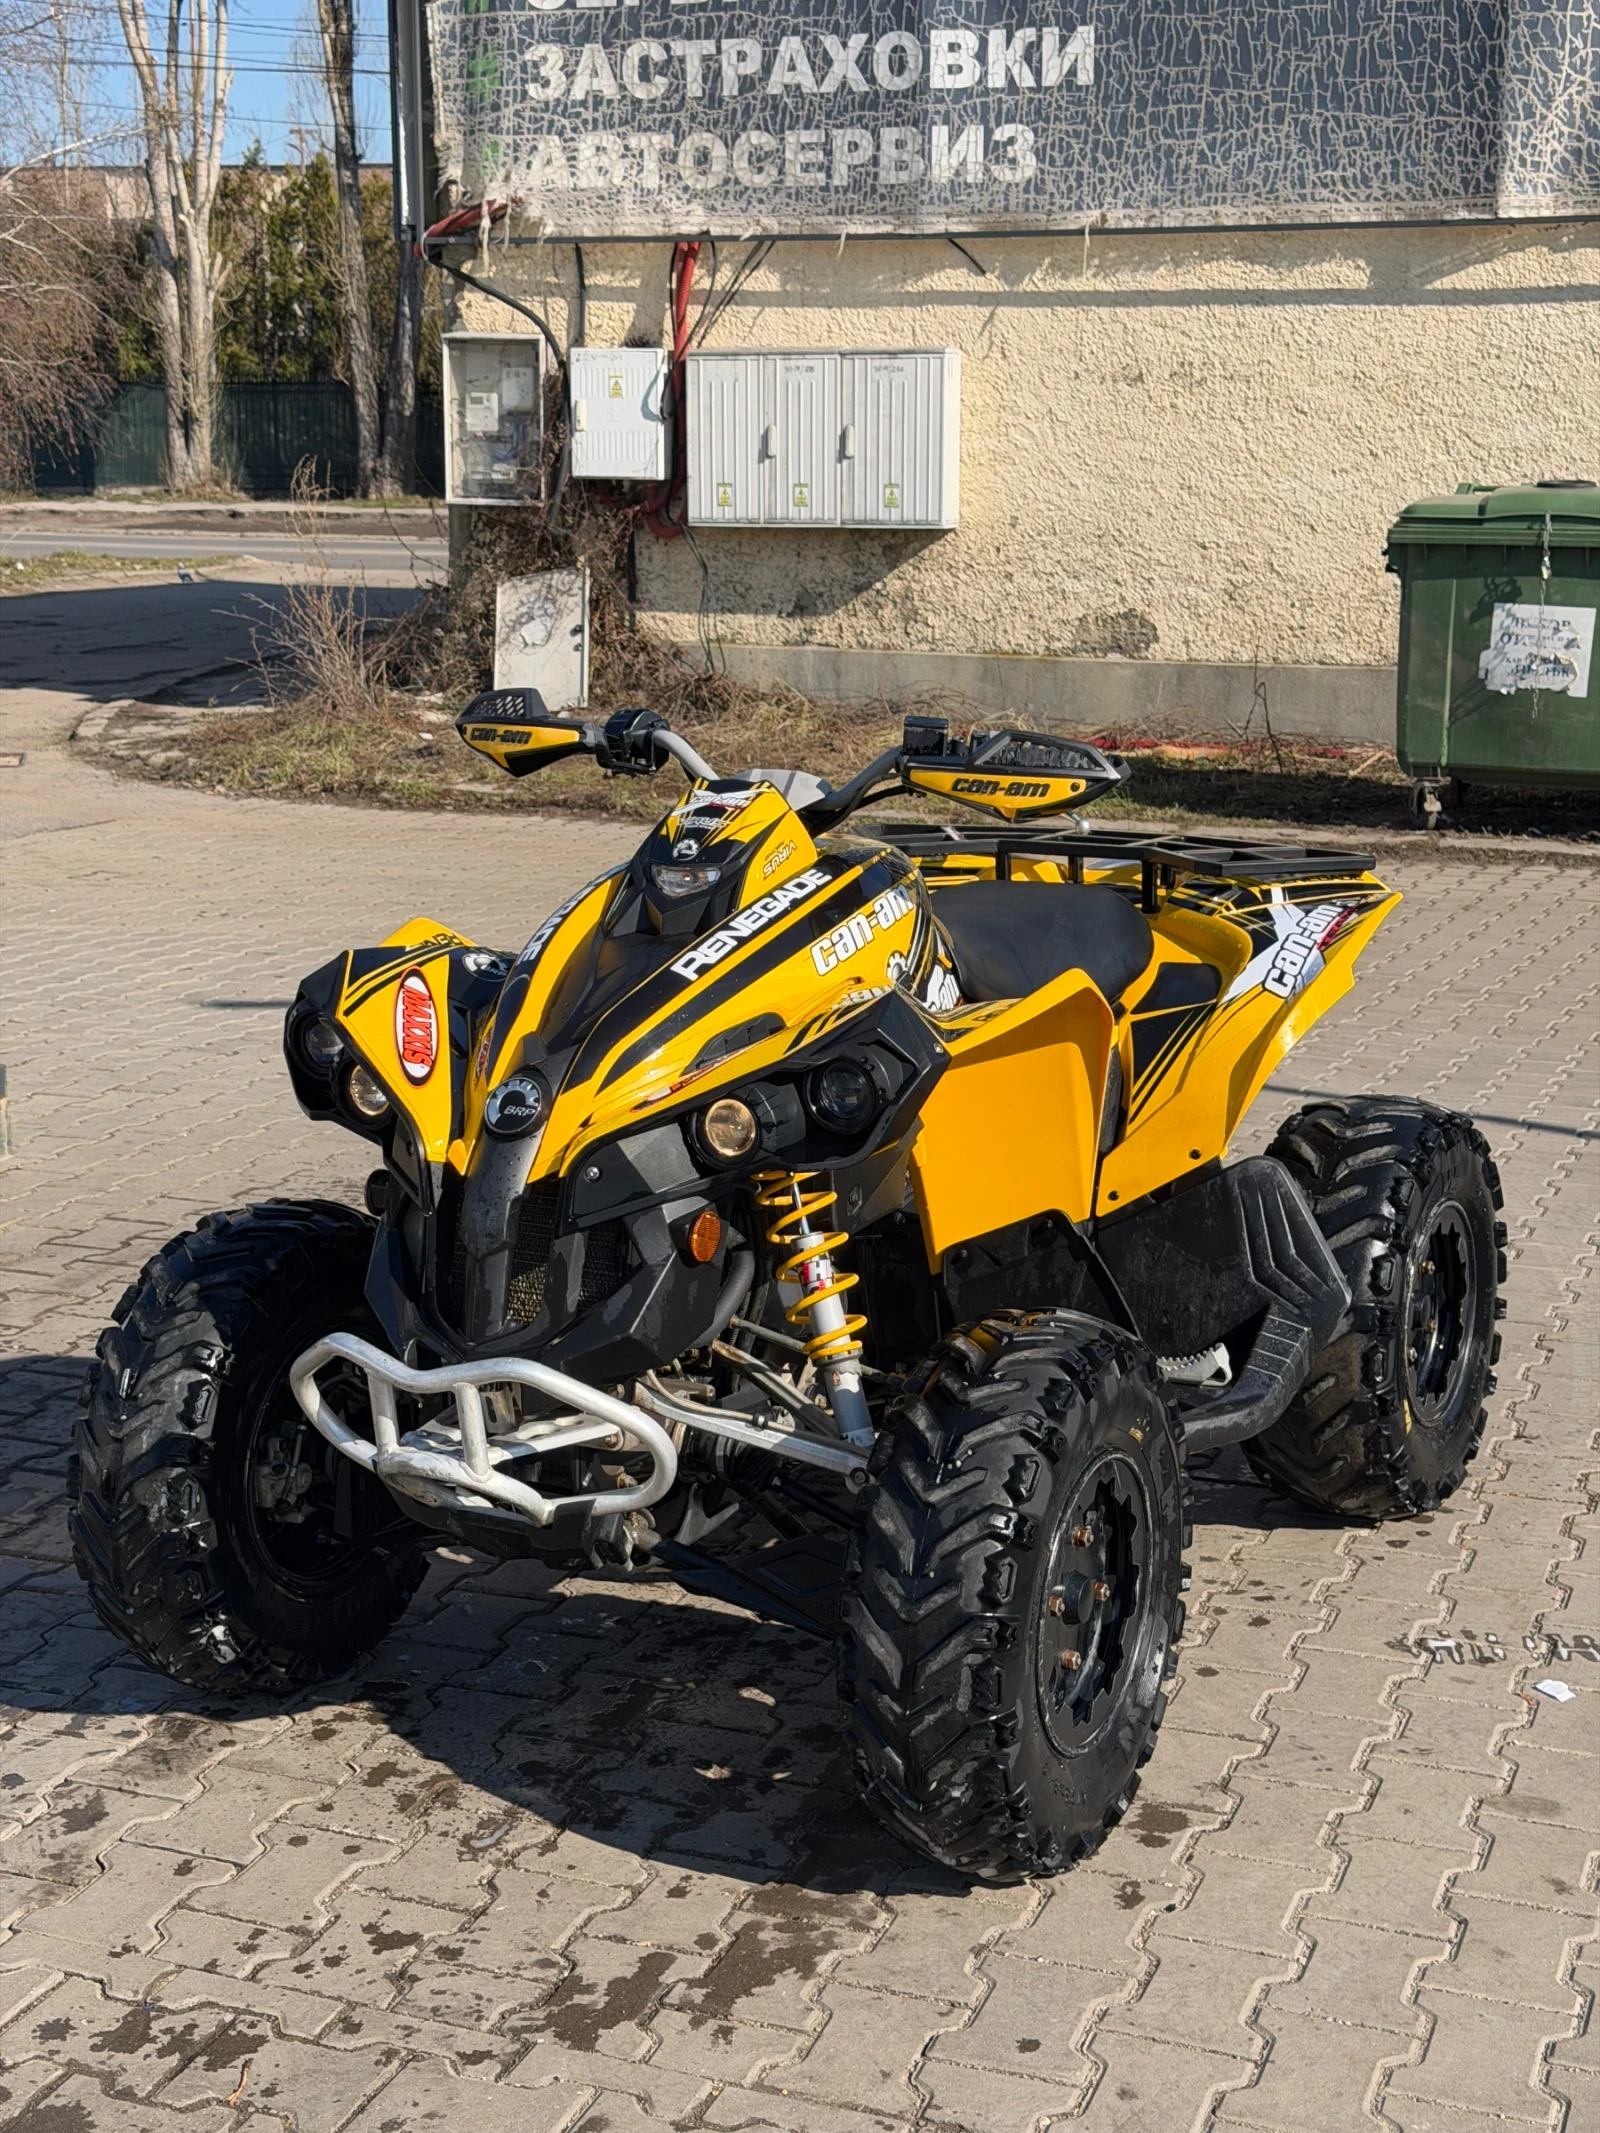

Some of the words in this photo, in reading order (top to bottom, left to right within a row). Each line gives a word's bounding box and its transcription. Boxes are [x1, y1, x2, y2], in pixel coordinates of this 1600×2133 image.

[524, 24, 1096, 101] ЗАСТРАХОВКИ
[526, 122, 1038, 189] АВТОСЕРВИЗ
[951, 777, 1050, 798] can-am
[670, 868, 833, 982] RENEGADE
[810, 884, 915, 977] can-am
[1262, 904, 1345, 1000] can-am
[402, 985, 433, 1068] MAXXIS
[503, 1105, 536, 1117] BRP
